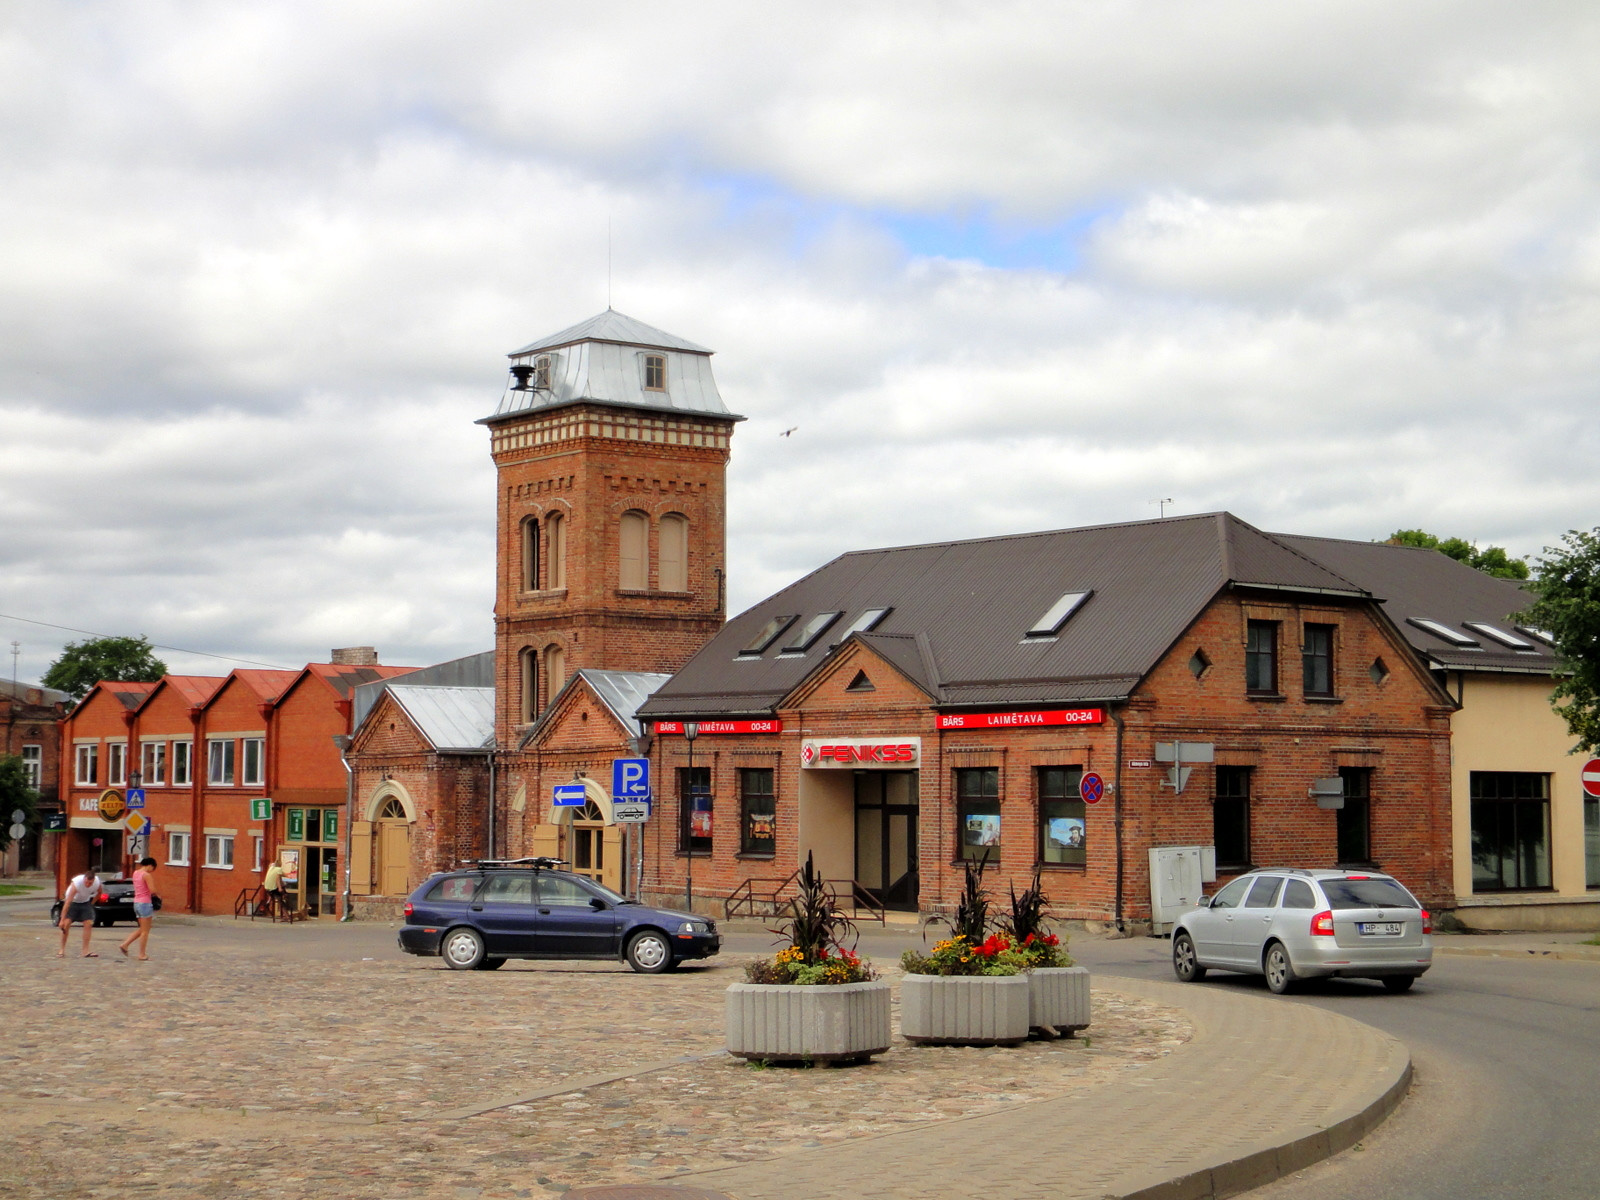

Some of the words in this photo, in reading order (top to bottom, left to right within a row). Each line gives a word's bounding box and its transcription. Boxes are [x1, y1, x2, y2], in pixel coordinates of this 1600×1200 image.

[660, 722, 676, 731] BĀRS
[698, 722, 735, 731] AIMĒTAVA
[942, 715, 964, 727] BĀRS
[988, 713, 1044, 725] LAIMĒTAVA
[1065, 711, 1093, 722] 00-24
[820, 744, 914, 763] FENIKSS
[622, 763, 643, 793] P
